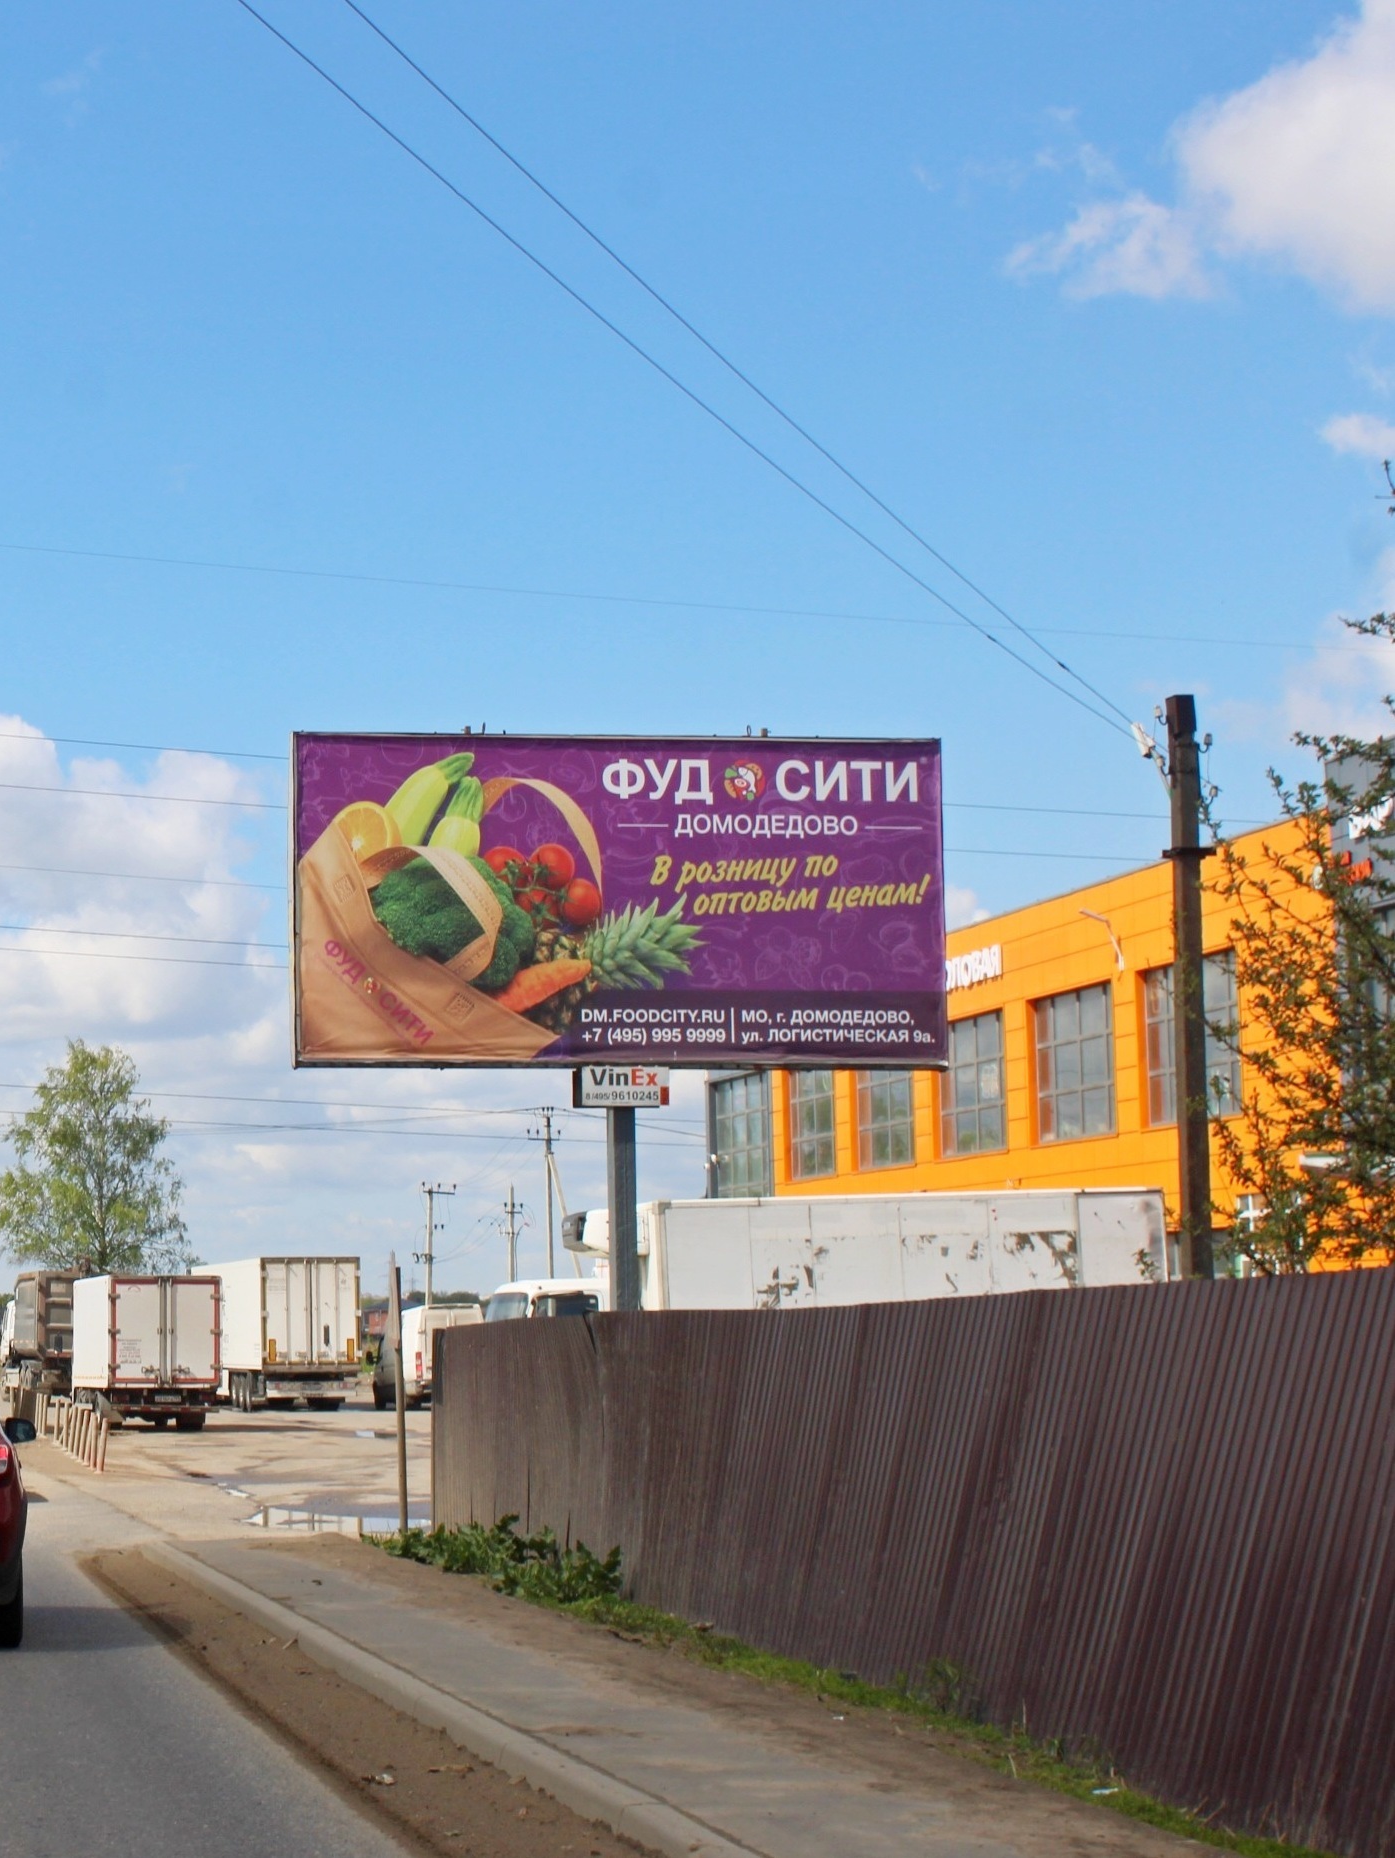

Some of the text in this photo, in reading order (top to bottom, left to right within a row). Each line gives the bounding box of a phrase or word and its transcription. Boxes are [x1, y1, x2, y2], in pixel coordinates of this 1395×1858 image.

[602, 758, 918, 805] ФУД СИТИ
[674, 814, 858, 838] ДОМОДЕДОВО
[650, 854, 839, 893] В розницу по
[693, 873, 931, 916] оптовым ценам!
[325, 939, 435, 1046] ФУД СИТИ
[581, 1008, 726, 1024] DM.FOODCITY.RU
[741, 1010, 915, 1027] МО, г. ДОМОДЕДОВО,
[582, 1028, 726, 1045] +7 (495) 995 9999
[741, 1032, 763, 1044] ул.
[767, 1029, 909, 1043] ЛОГИСТИЧЕСКАЯ
[590, 1068, 658, 1087] VinEx
[611, 1091, 659, 1100] 9610245
